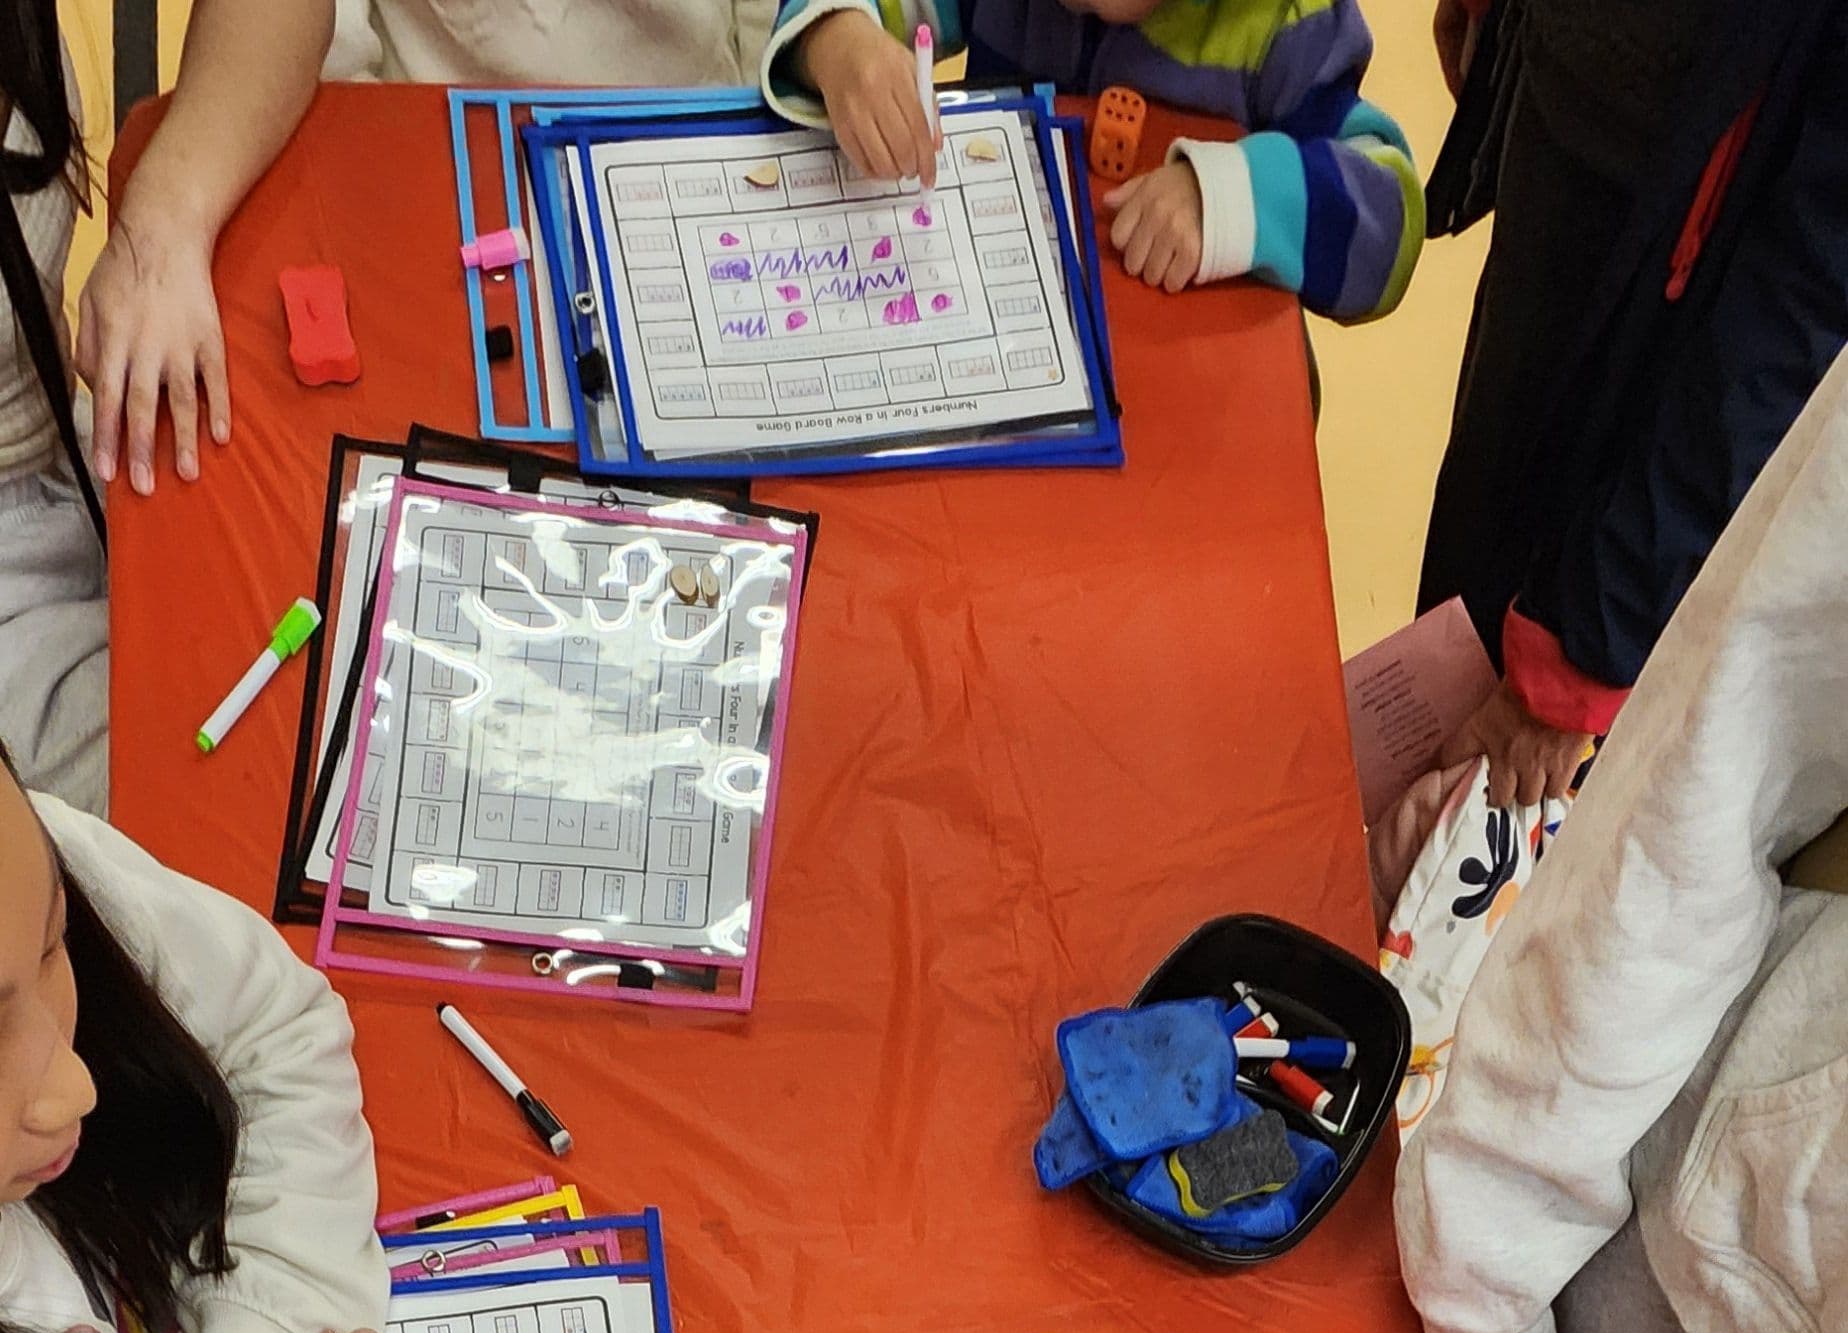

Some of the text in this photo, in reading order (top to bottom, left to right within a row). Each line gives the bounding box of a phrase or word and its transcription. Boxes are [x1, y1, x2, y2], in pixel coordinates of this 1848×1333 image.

[922, 400, 977, 415] Numbers
[866, 413, 873, 421] a
[892, 408, 919, 417] Four
[795, 418, 832, 429] Board
[836, 414, 861, 425] Row
[757, 422, 791, 431] Game
[730, 696, 739, 719] Four
[487, 812, 502, 821] 5
[557, 819, 574, 828] 2
[594, 821, 609, 830] 4
[721, 812, 733, 843] Game
